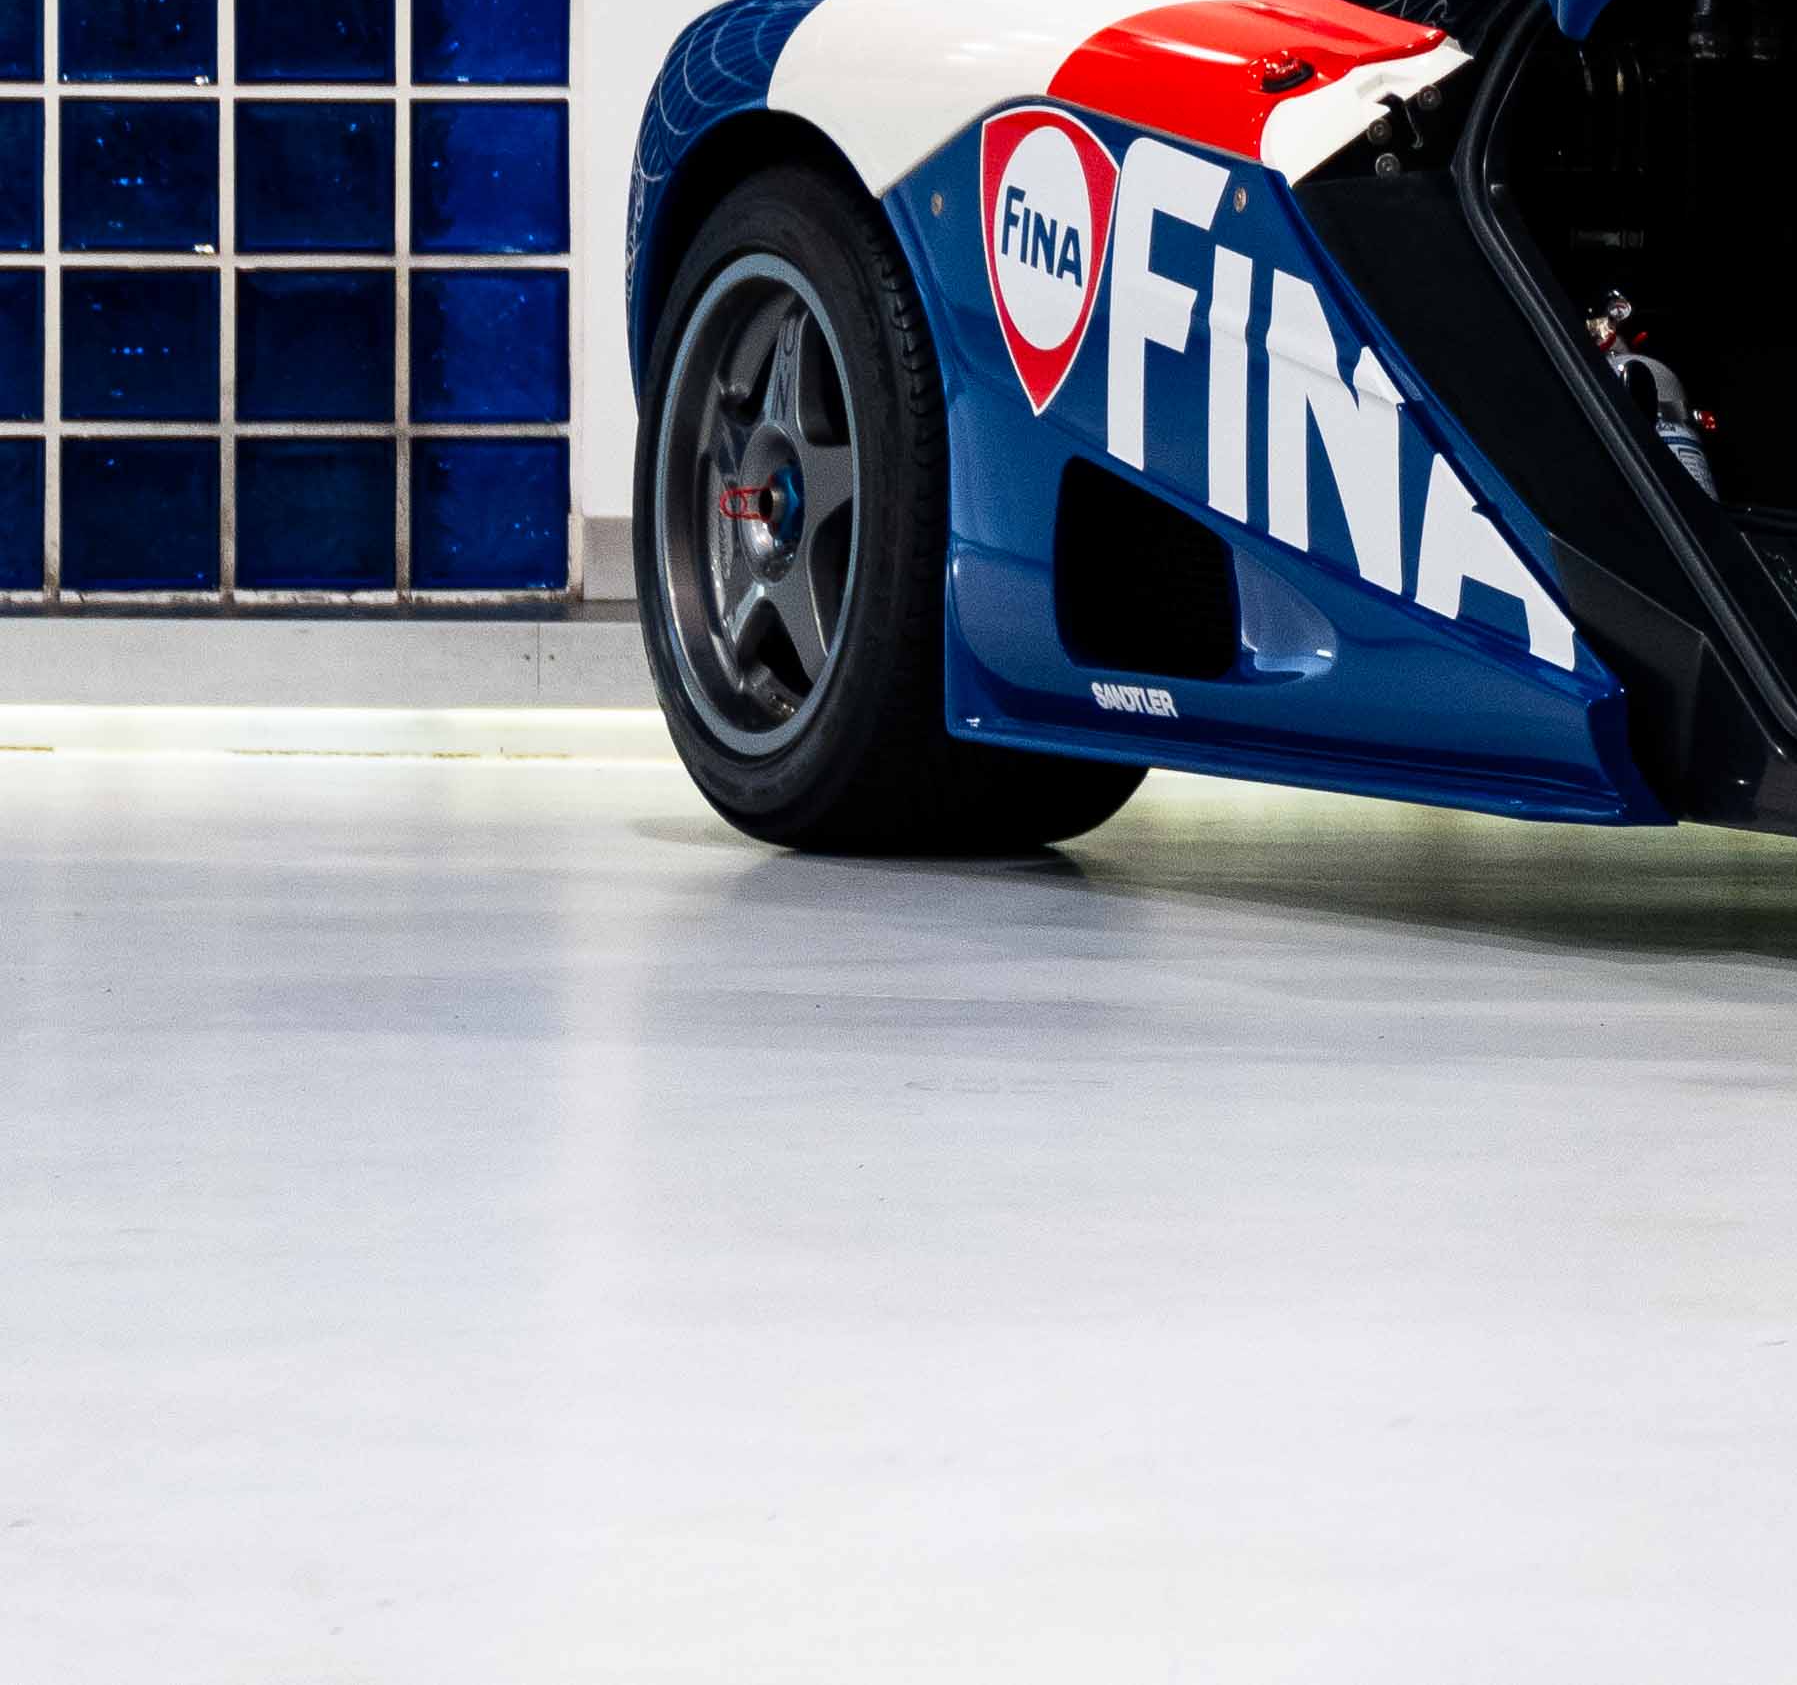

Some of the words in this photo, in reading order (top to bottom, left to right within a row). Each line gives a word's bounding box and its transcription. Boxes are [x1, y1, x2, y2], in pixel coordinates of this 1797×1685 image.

[1000, 185, 1084, 289] FINA
[1106, 136, 1576, 673] FINA
[1090, 681, 1179, 718] SANDTLER
